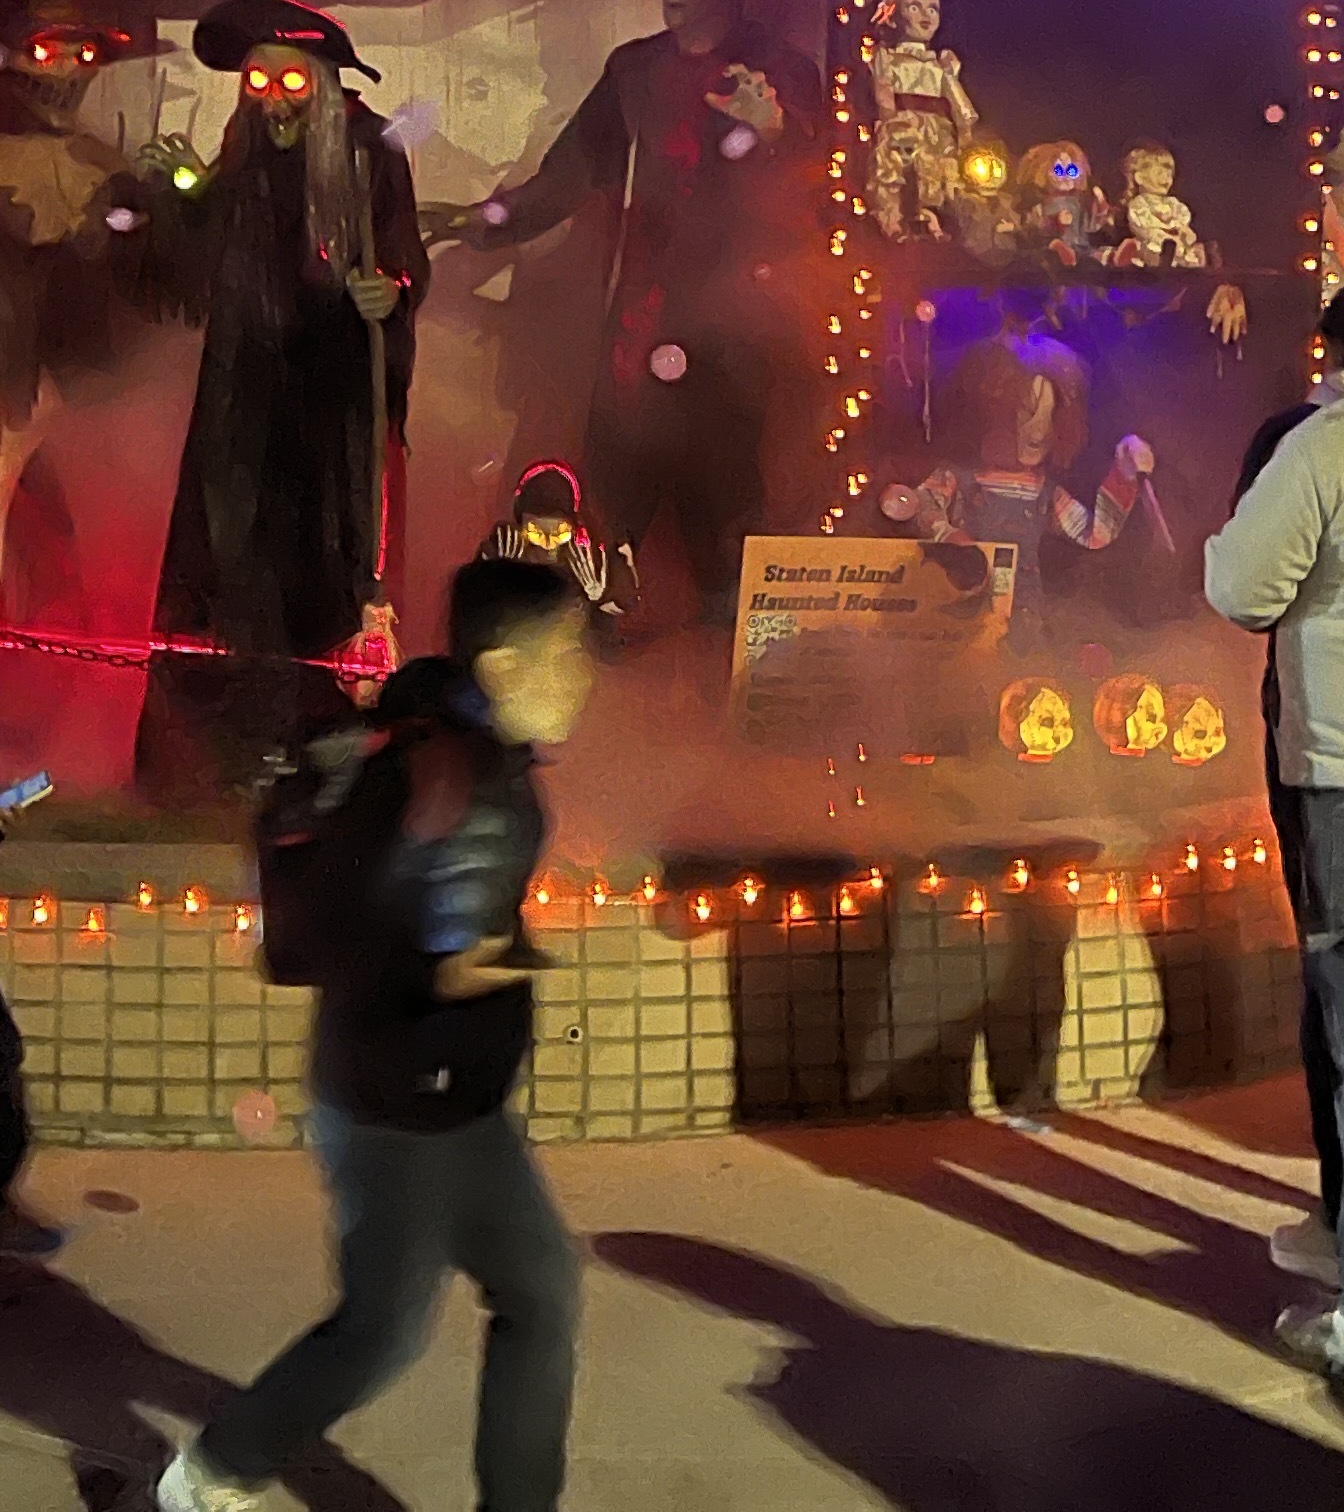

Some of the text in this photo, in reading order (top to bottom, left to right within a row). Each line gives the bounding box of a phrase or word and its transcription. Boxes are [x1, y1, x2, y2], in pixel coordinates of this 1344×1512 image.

[764, 564, 905, 584] Staten Island
[749, 591, 840, 611] Haunted
